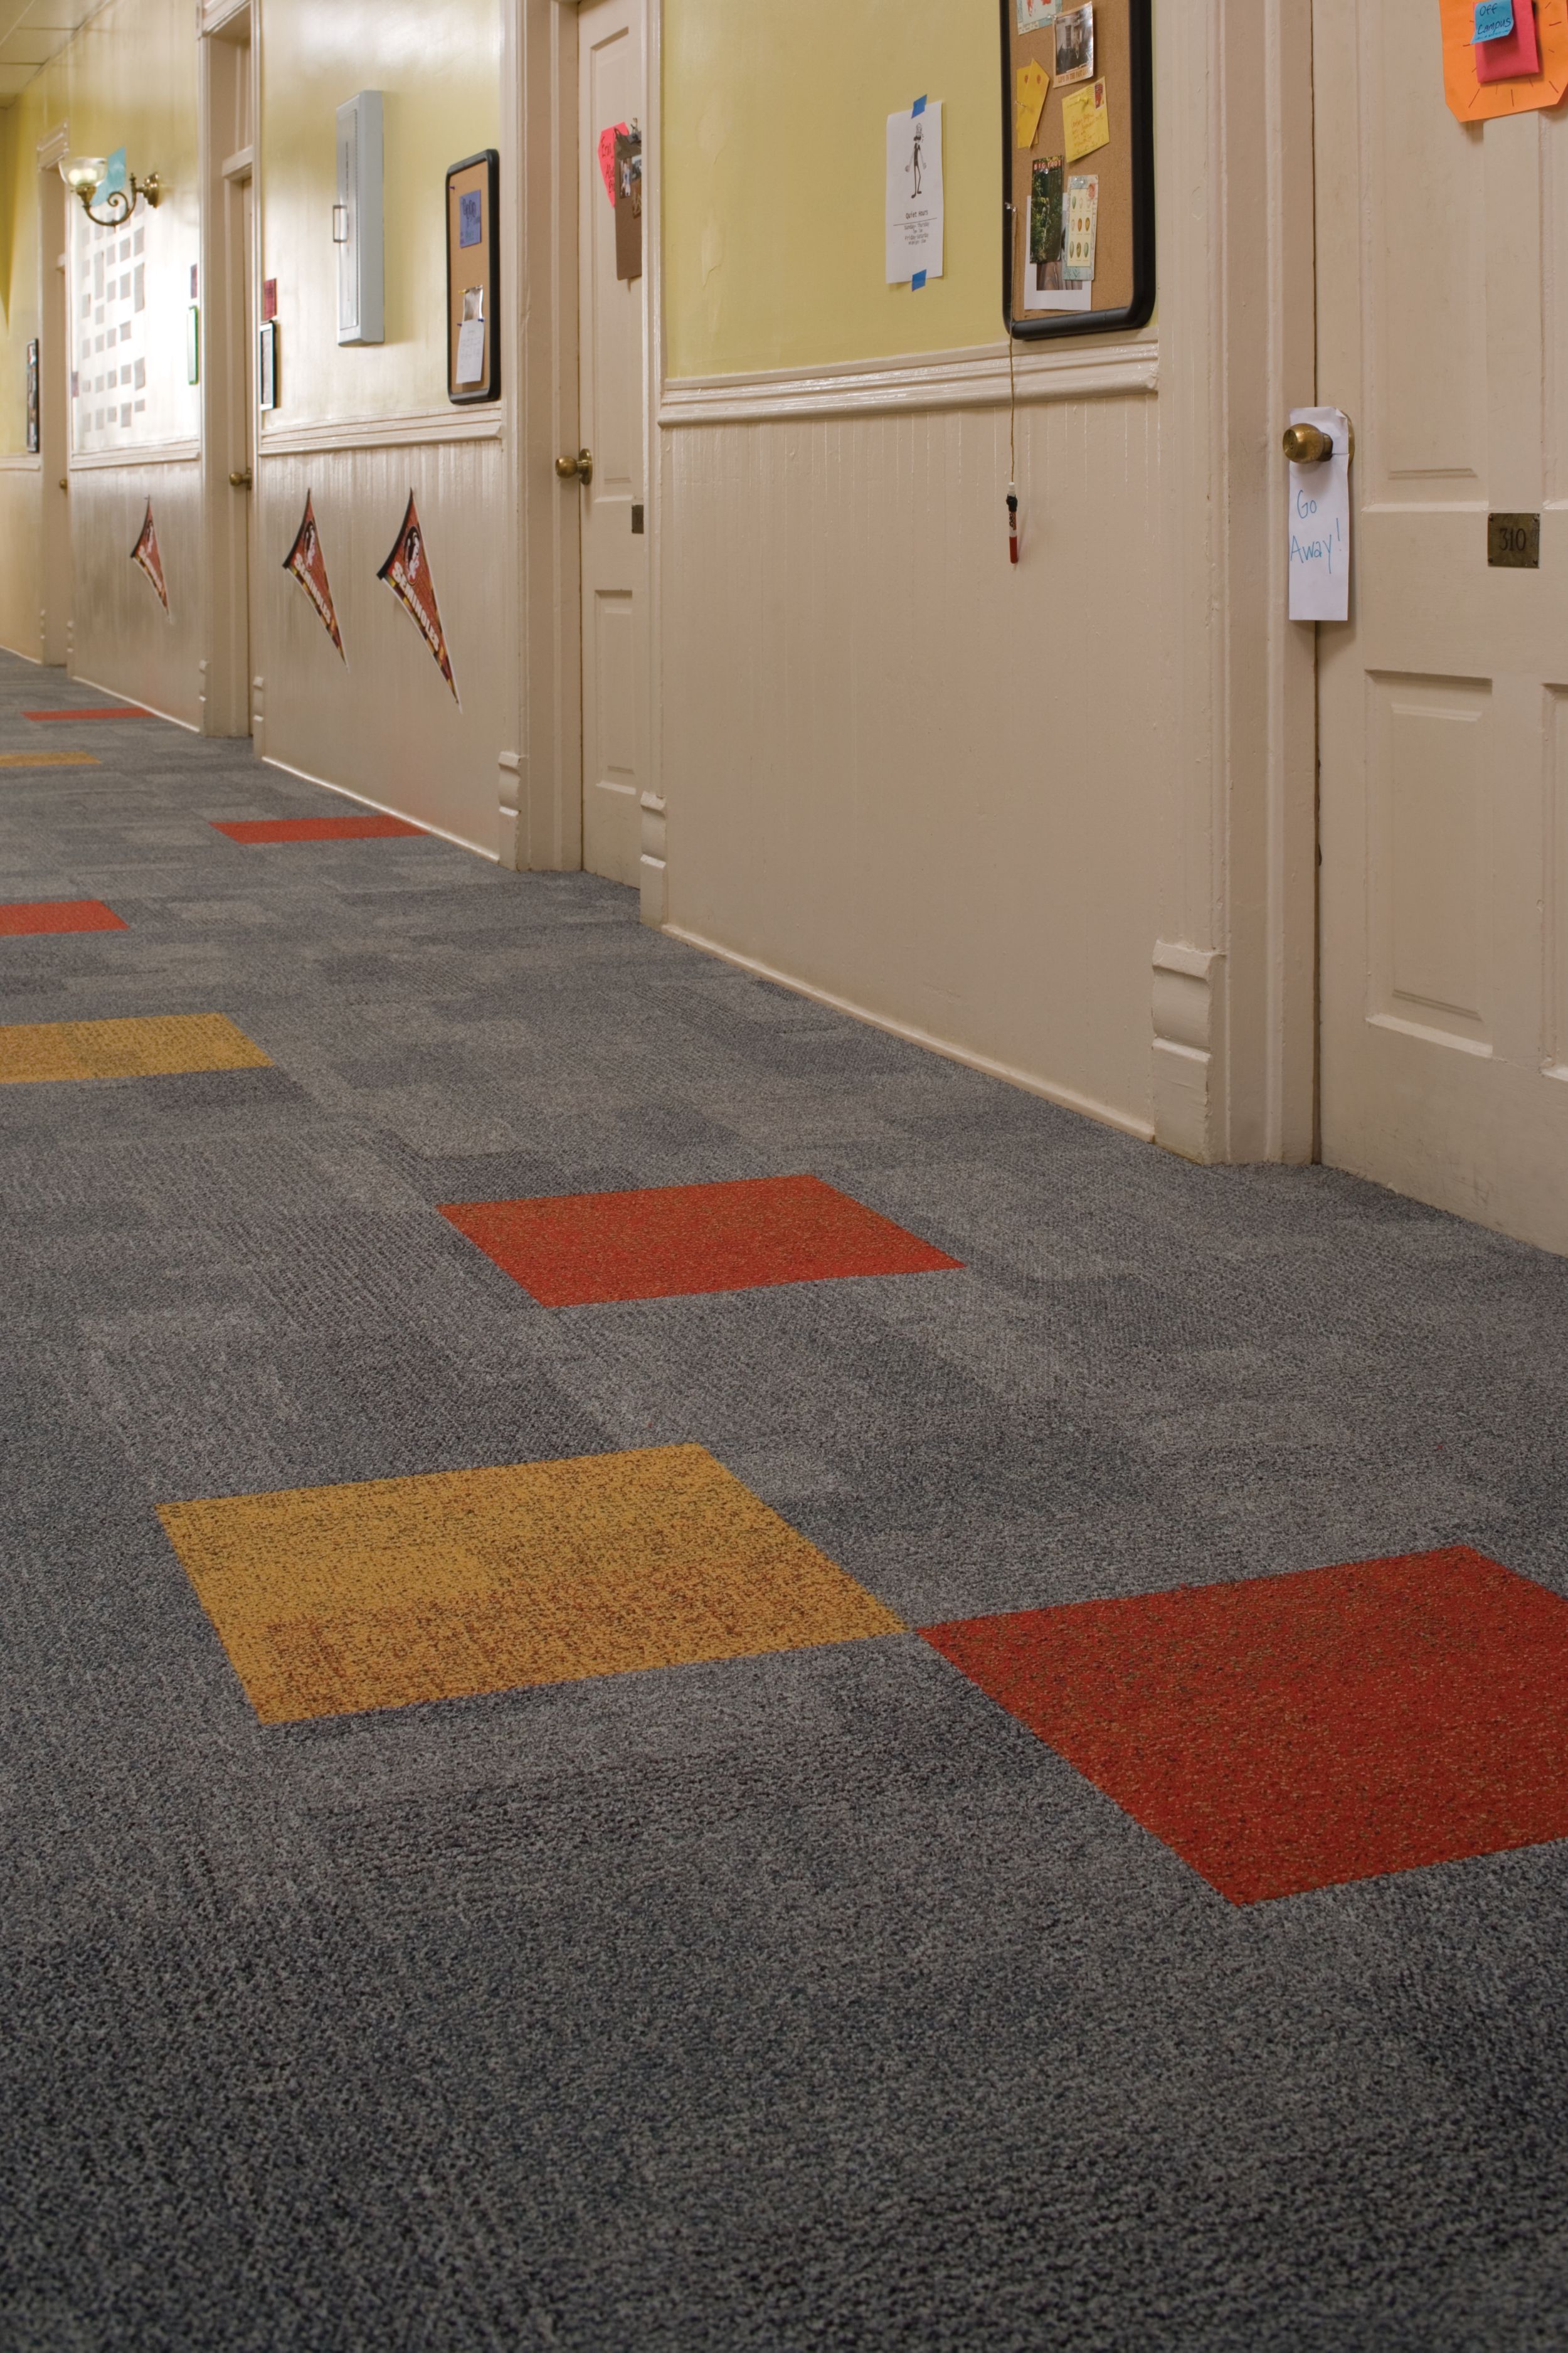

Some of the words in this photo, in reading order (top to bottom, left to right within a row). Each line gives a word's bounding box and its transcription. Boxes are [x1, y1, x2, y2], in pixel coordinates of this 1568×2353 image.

[1480, 3, 1498, 16] Off
[1477, 18, 1511, 35] Campus
[1297, 489, 1316, 519] Go
[1290, 517, 1342, 574] Away!
[1499, 528, 1526, 551] 310
[391, 561, 440, 651] SEMINOLES
